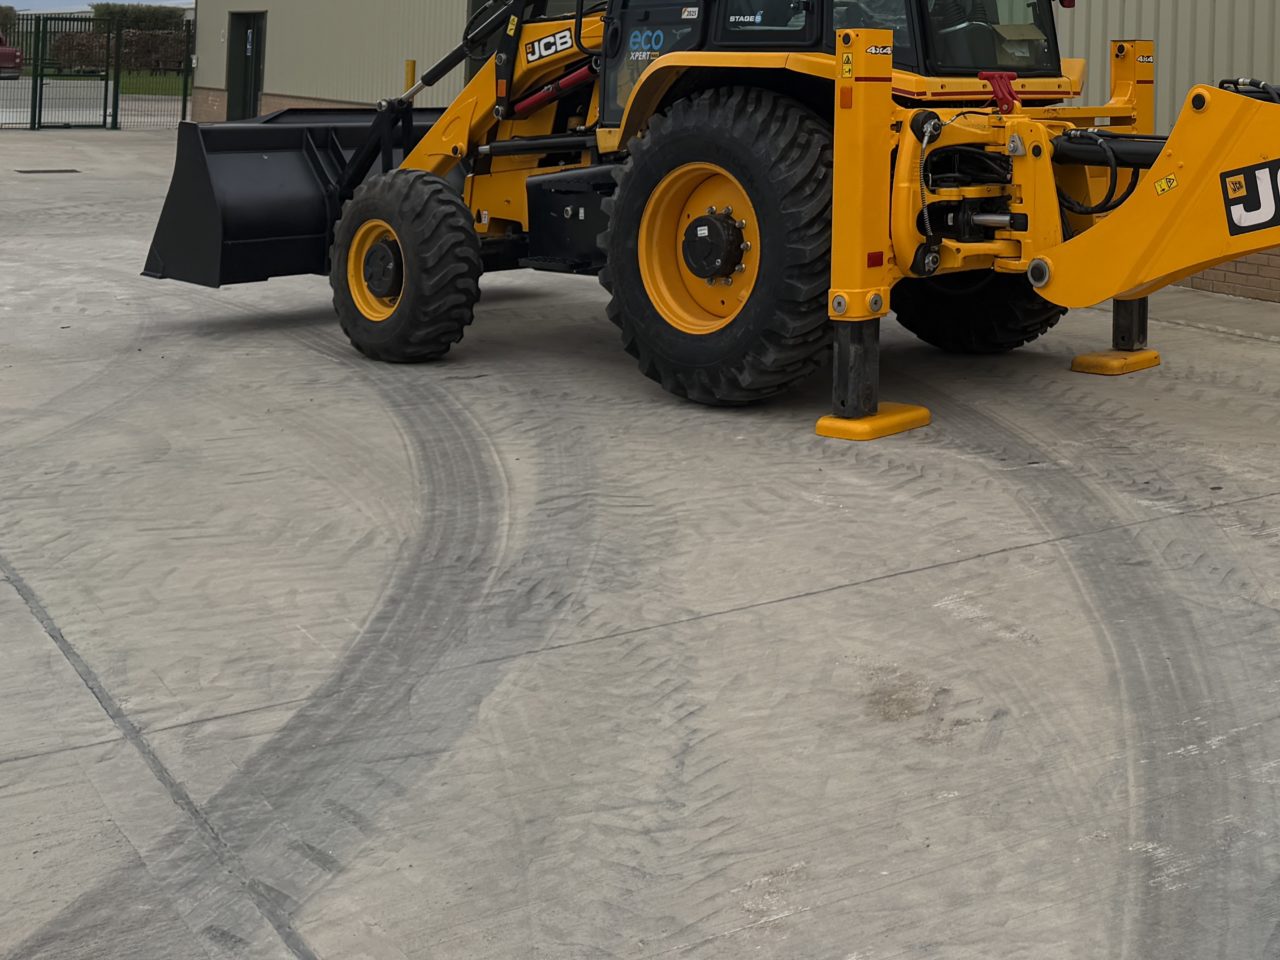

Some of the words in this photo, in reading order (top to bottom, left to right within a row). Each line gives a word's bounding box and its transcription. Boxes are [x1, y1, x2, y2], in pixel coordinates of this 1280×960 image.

[527, 30, 573, 61] JCB
[629, 30, 664, 50] eco
[630, 51, 651, 60] XPERT
